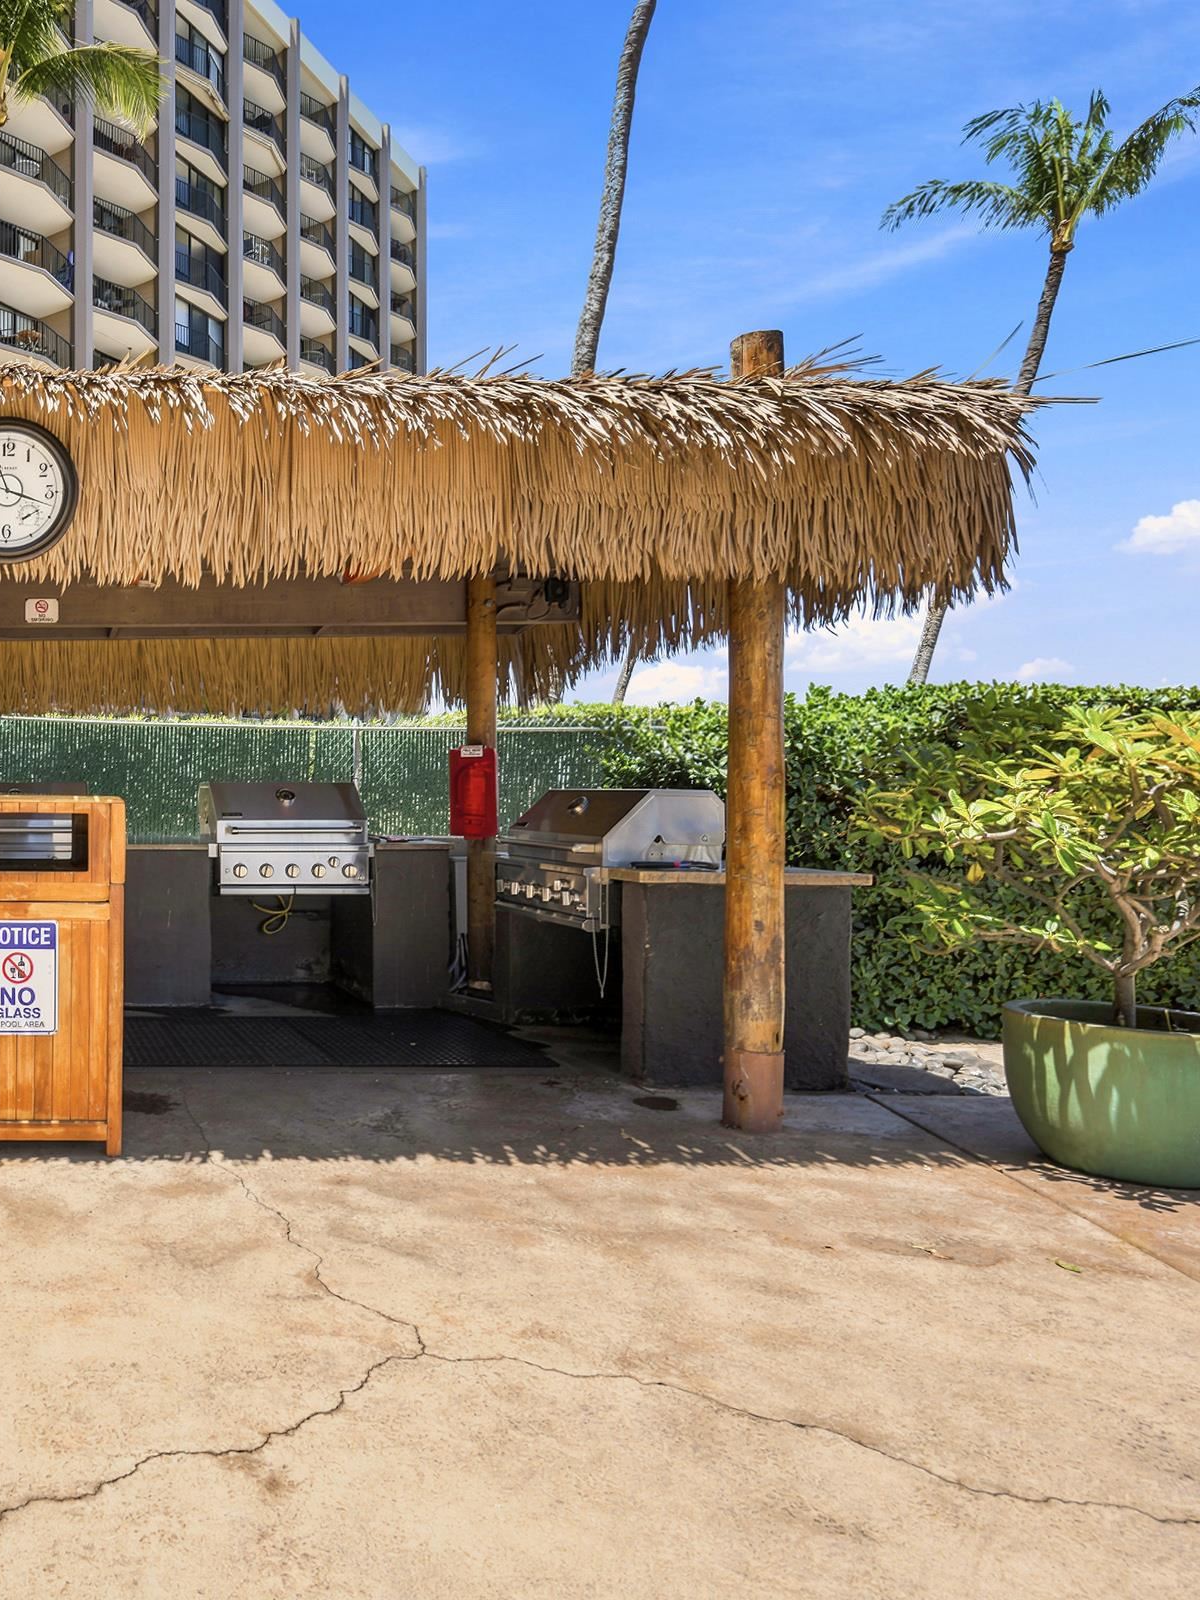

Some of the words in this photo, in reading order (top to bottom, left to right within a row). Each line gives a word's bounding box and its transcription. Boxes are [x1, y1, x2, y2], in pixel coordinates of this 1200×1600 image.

[2, 442, 16, 457] 12
[26, 448, 31, 462] 1
[39, 463, 48, 477] 2
[44, 485, 54, 499] 3
[1, 524, 11, 539] 6
[0, 987, 36, 1006] NO
